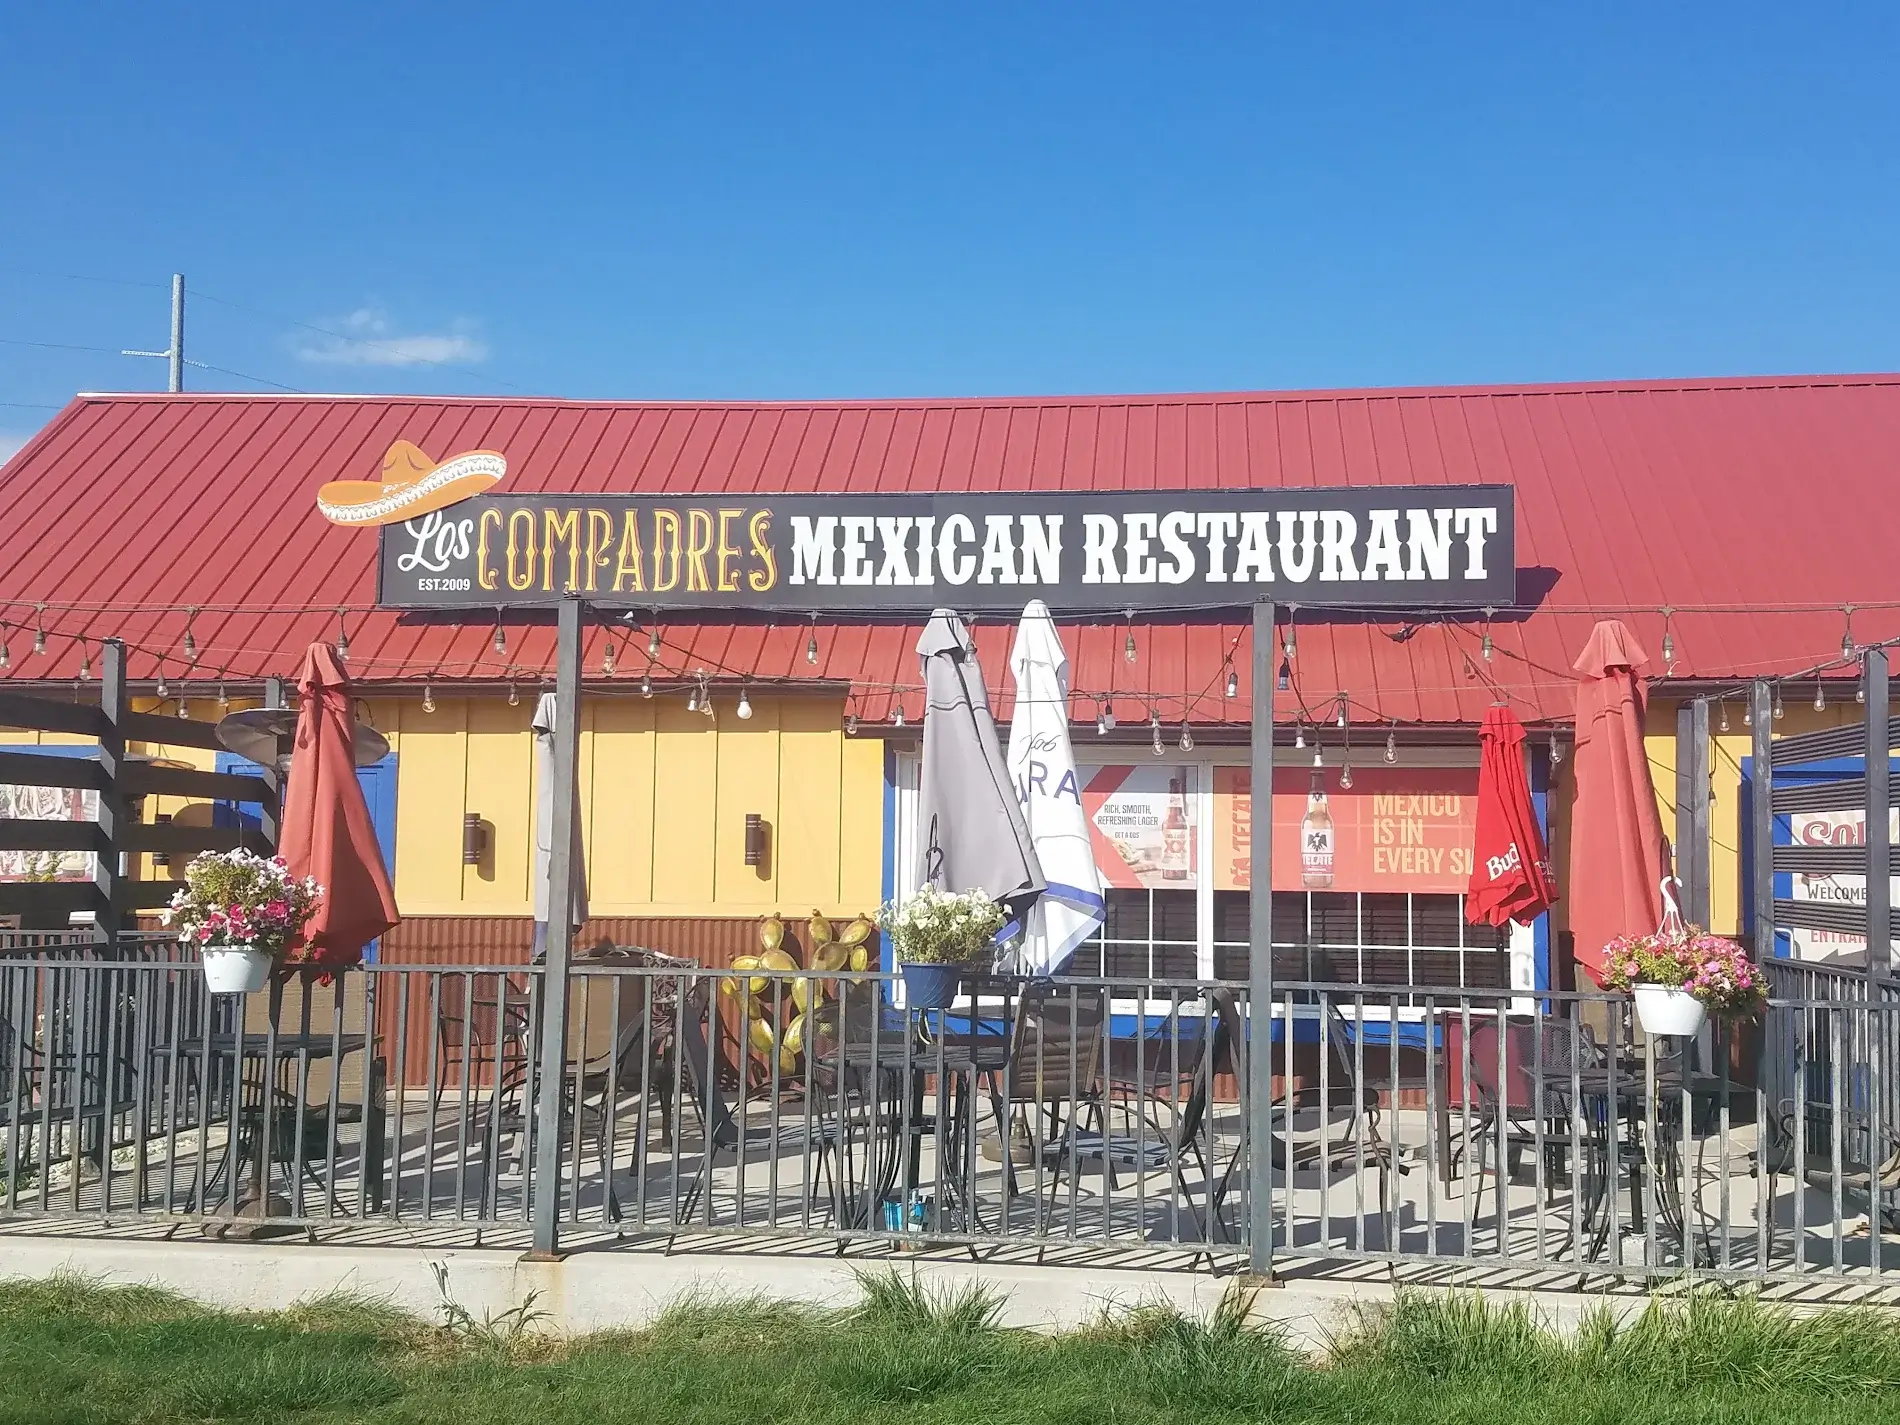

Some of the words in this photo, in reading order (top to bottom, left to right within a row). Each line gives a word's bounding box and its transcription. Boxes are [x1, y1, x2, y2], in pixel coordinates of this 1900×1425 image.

[397, 511, 474, 572] Los
[476, 507, 779, 593] COMPADRES
[789, 513, 1064, 586] MEXICAN
[1081, 507, 1498, 585] RESTAURANT
[418, 578, 471, 591] EST.2009
[1015, 760, 1081, 806] RA
[1104, 804, 1121, 815] RICH,
[1122, 804, 1152, 815] SMOOTH,
[1373, 789, 1460, 817] MEXICO
[1097, 815, 1137, 826] REFRESHING
[1138, 816, 1158, 826] LAGER
[1373, 818, 1395, 845] IS
[1400, 818, 1424, 845] IN
[1373, 847, 1445, 875] EVERY
